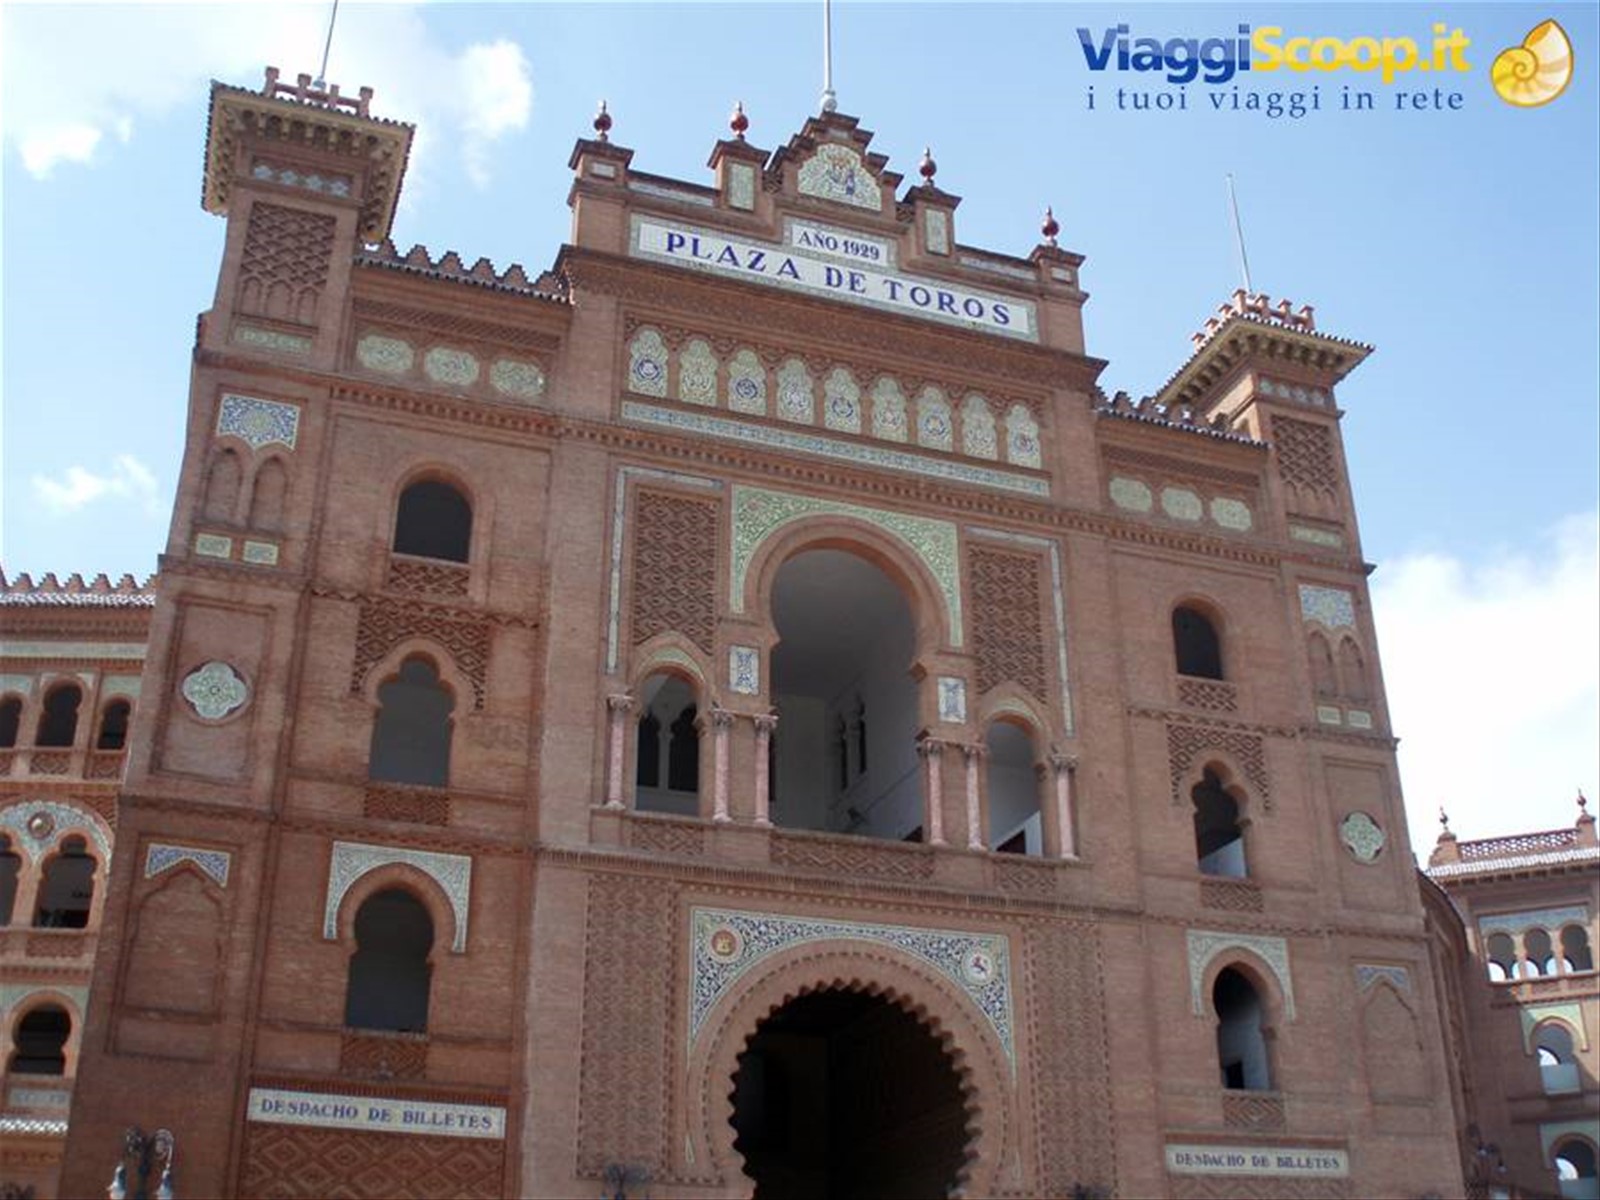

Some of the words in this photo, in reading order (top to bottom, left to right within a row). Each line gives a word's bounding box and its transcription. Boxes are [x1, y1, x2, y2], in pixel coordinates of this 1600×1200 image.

[798, 228, 838, 252] AÑO
[842, 239, 880, 261] 1929
[665, 231, 800, 280] PLAZA
[825, 266, 867, 294] DE
[883, 279, 1011, 326] TOROS
[261, 1098, 358, 1120] DESPACHO
[368, 1107, 392, 1123] DE
[402, 1109, 492, 1130] BILLETES
[1175, 1153, 1246, 1168] DESPACHO
[1252, 1156, 1269, 1168] DE
[1277, 1156, 1340, 1169] BILLETES
